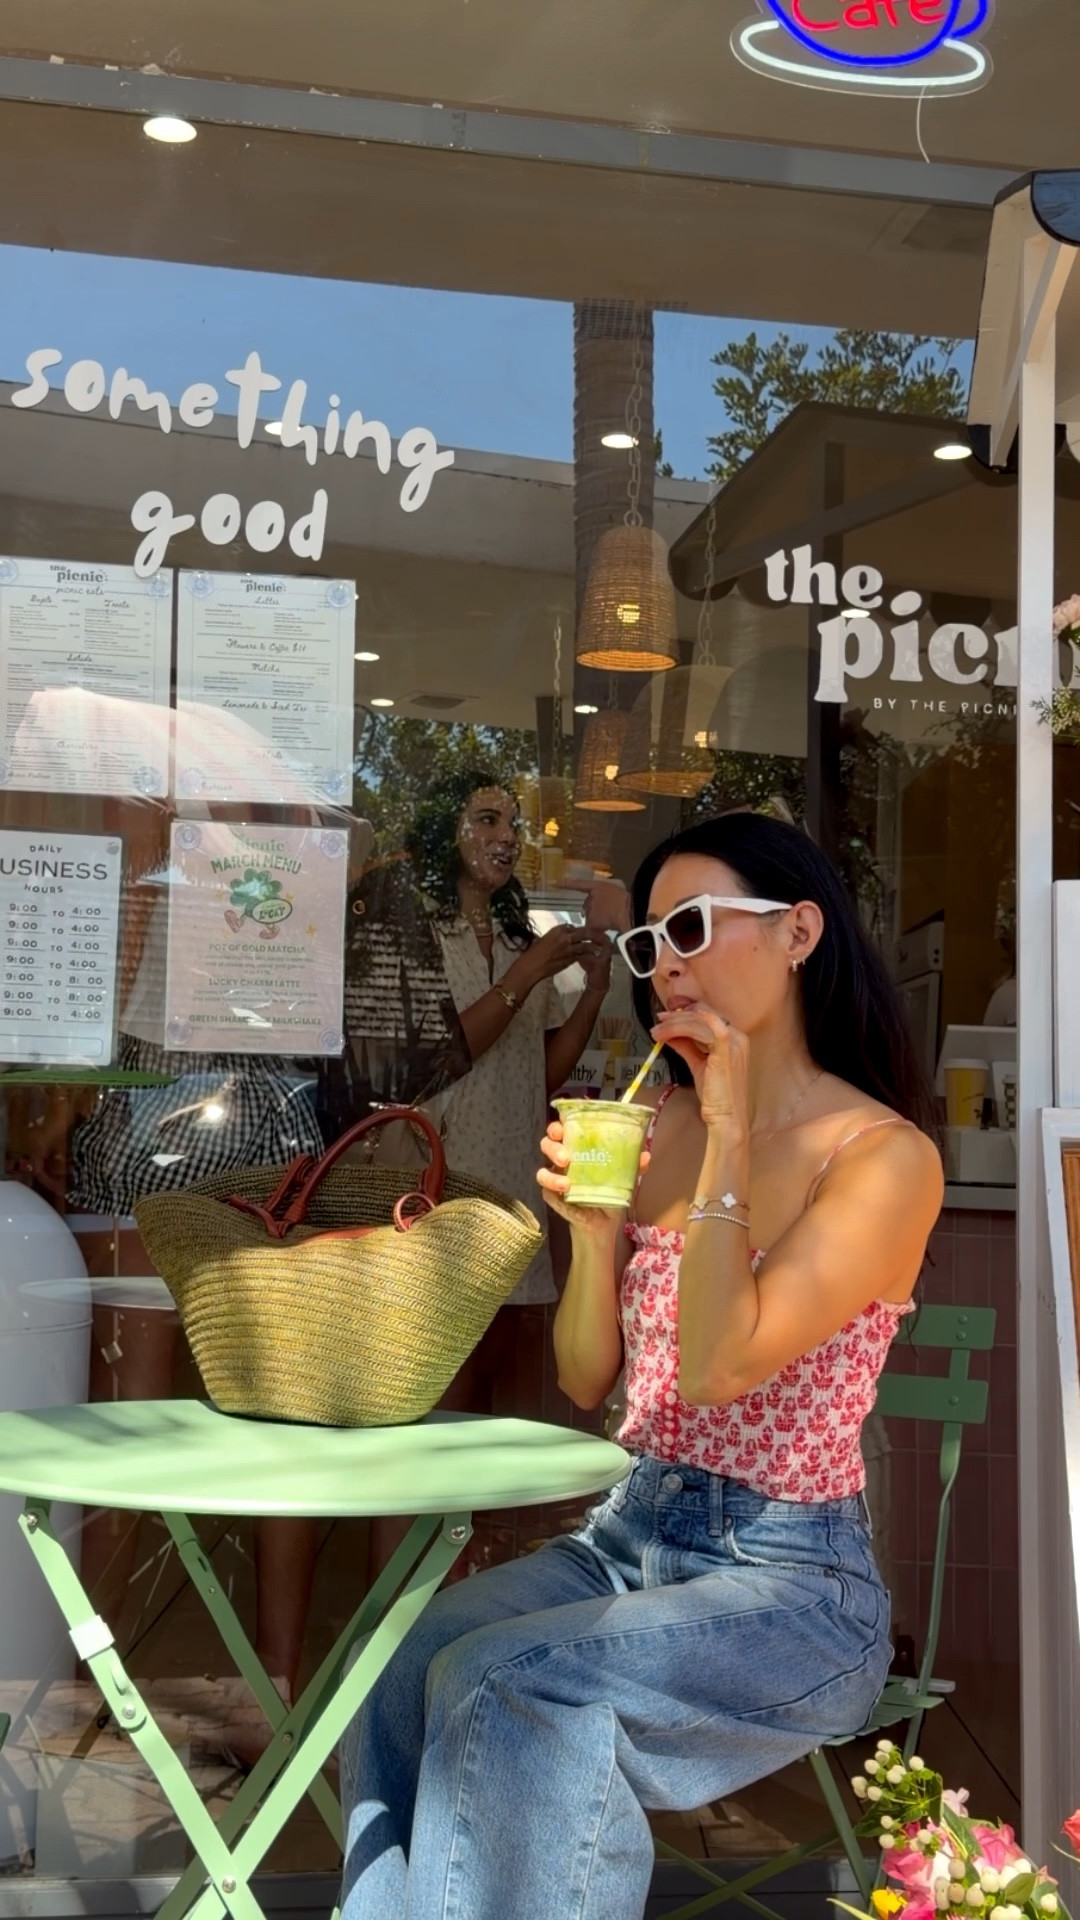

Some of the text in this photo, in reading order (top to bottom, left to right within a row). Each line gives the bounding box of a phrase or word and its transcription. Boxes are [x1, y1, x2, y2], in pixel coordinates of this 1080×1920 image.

[11, 348, 455, 512] something
[131, 489, 328, 578] good
[56, 569, 104, 583] picnic
[764, 544, 883, 609] the
[246, 581, 283, 593] picnic
[873, 697, 1017, 715] BY THE PICNI
[29, 844, 62, 853] DAILY
[0, 858, 108, 880] USINESS
[210, 853, 302, 875] MARCH MENU
[24, 883, 64, 894] HOURS
[9, 903, 38, 913] 9:00
[52, 910, 65, 918] TO
[8, 920, 38, 930] 9:00
[52, 927, 64, 935] TO
[7, 938, 38, 948] 9:00
[241, 944, 266, 953] GOLD
[267, 945, 307, 954] MATCHA
[6, 955, 35, 965] 9:00
[5, 972, 34, 981] 9:00
[4, 990, 33, 999] 9:00
[3, 1008, 32, 1016] 9:00
[188, 1014, 218, 1023] GREEN
